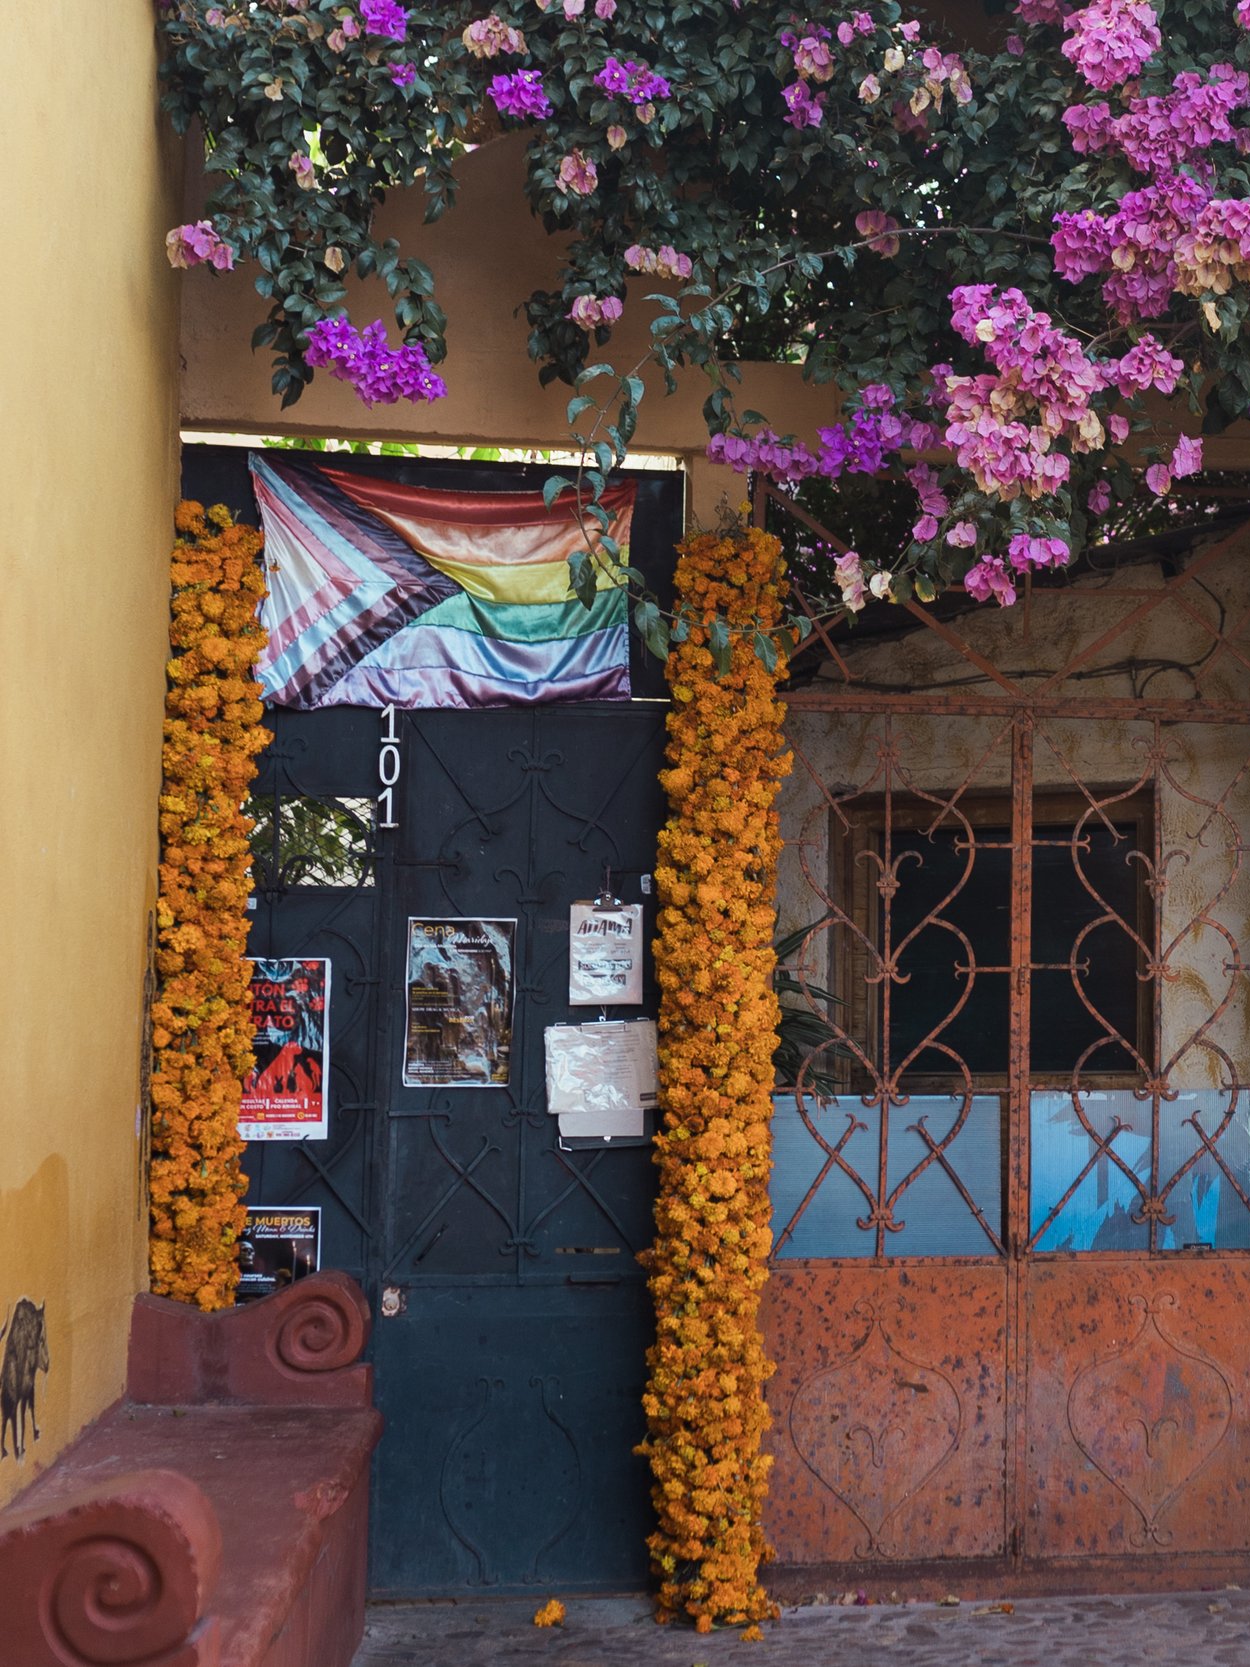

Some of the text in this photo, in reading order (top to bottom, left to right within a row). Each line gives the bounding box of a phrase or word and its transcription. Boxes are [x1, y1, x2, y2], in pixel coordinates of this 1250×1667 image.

[378, 703, 400, 828] 101
[411, 922, 455, 938] Cena
[280, 999, 296, 1013] EL
[255, 1216, 311, 1226] MUERTOS
